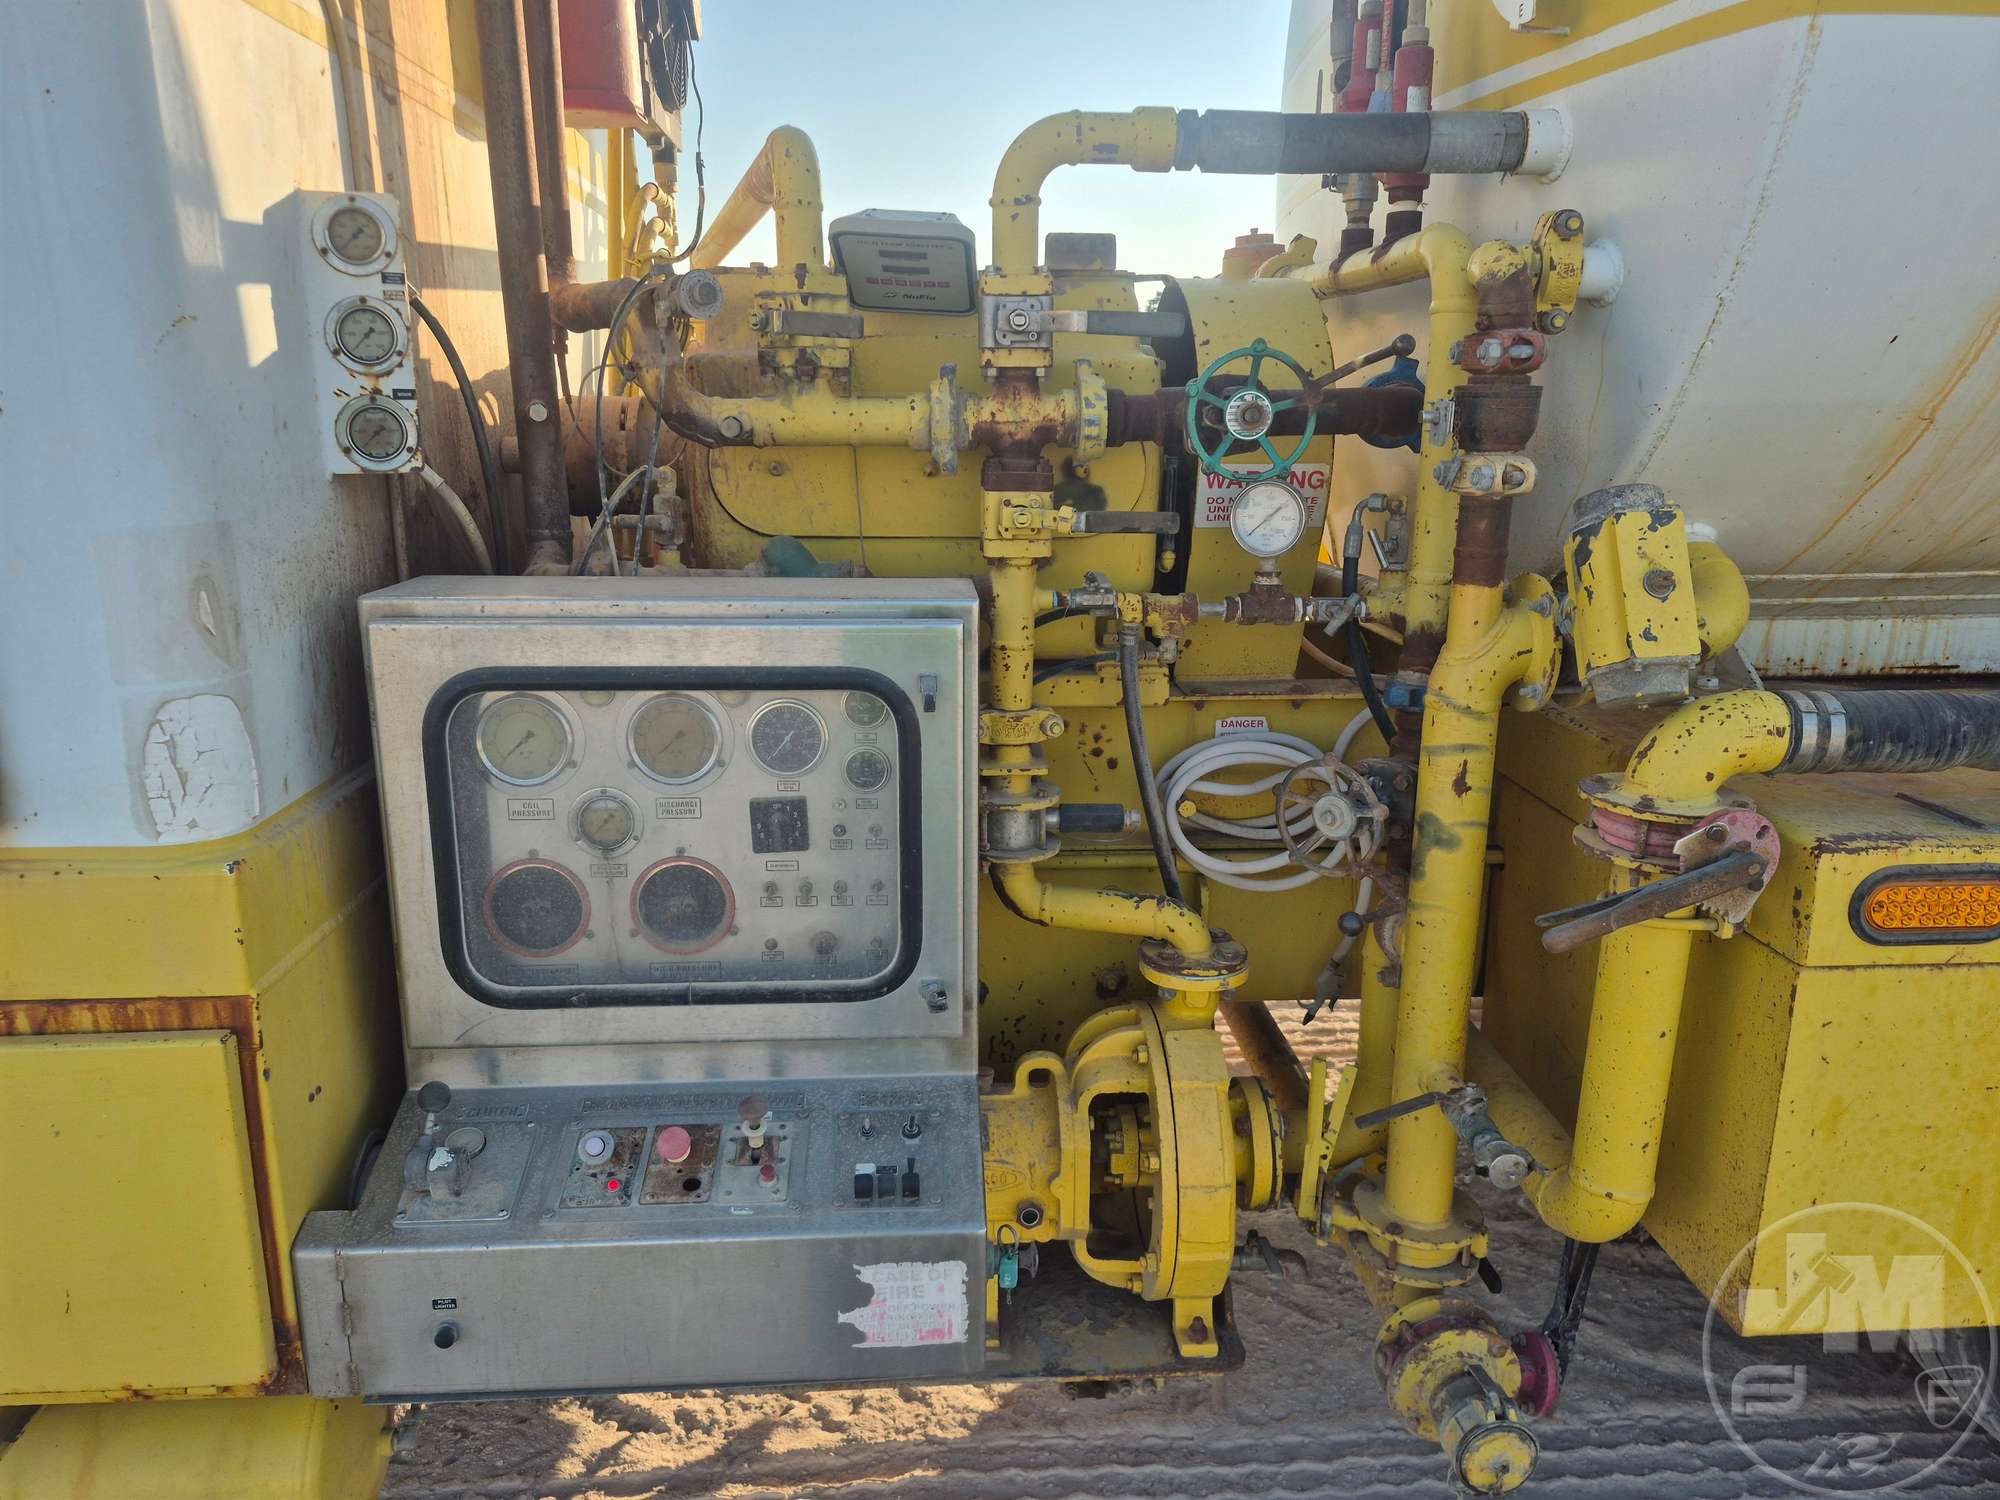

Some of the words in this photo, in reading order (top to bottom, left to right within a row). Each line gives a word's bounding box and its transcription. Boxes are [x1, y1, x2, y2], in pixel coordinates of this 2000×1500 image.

[1206, 470, 1325, 489] WANG
[1206, 496, 1225, 505] DO
[1208, 505, 1232, 514] UNI
[1220, 719, 1264, 728] DANGER
[522, 801, 540, 809] COIL
[659, 800, 697, 808] DISCHARGE
[512, 809, 550, 817] PRESSURE
[661, 808, 696, 816] PRESSURE
[927, 1267, 954, 1281] OF
[875, 1284, 925, 1299] FIRE
